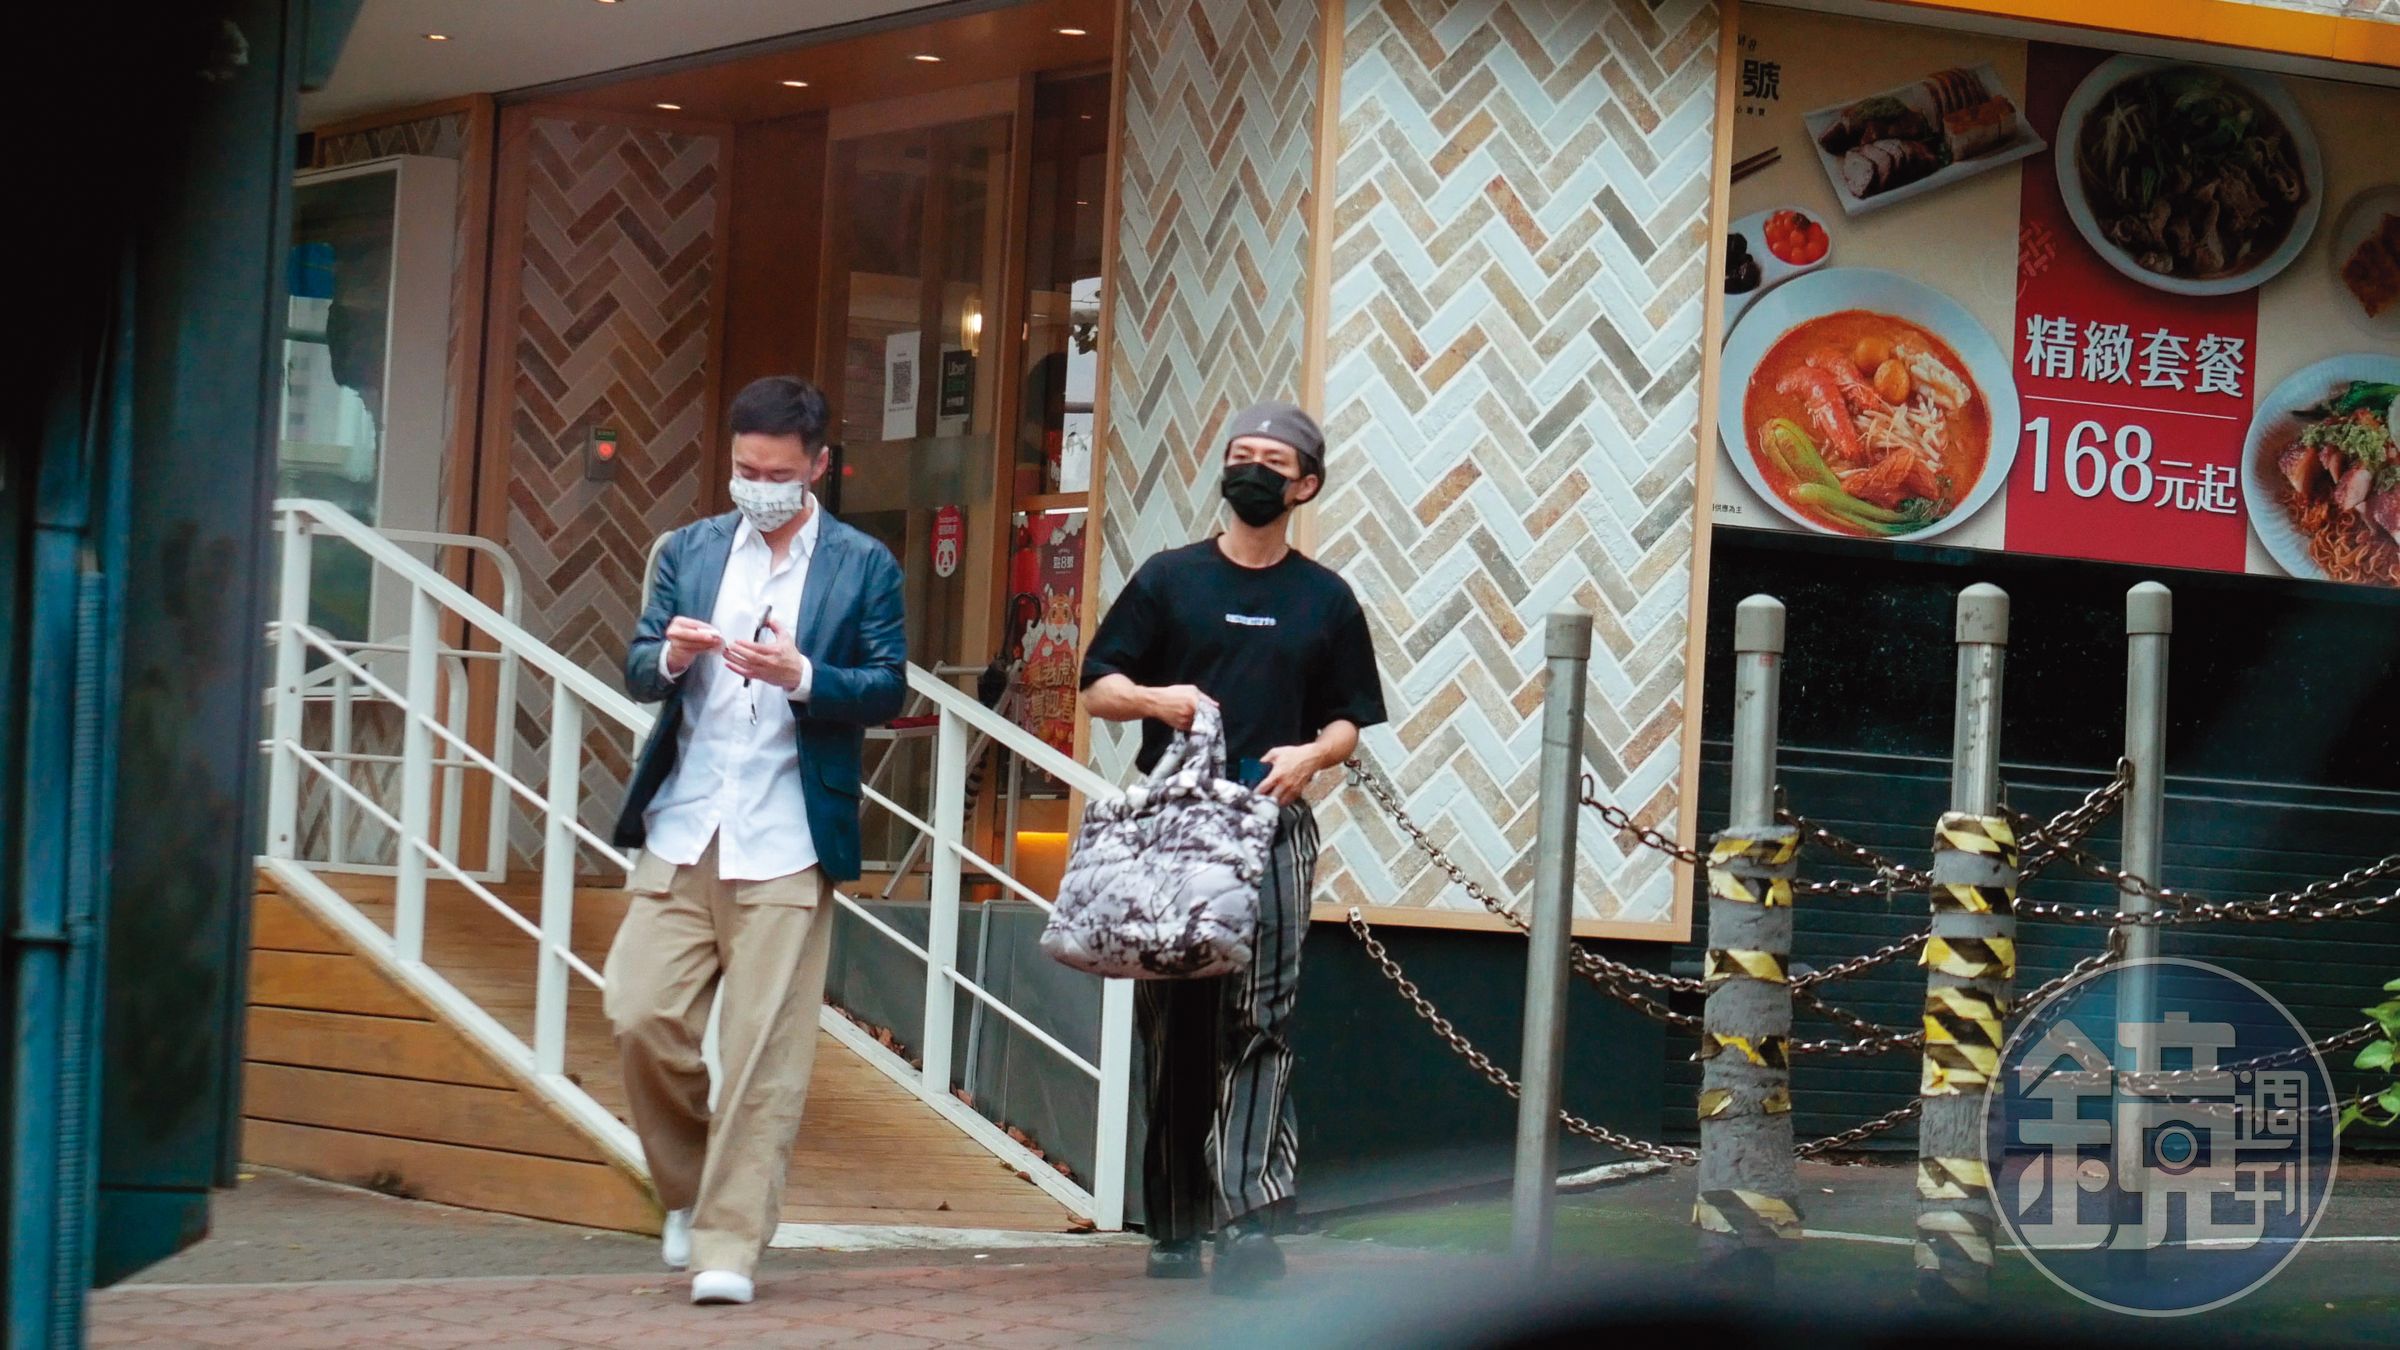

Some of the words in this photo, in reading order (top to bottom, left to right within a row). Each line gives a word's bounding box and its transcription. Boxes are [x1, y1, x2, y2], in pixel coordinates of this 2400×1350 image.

[1743, 59, 1781, 101] 號
[2024, 313, 2245, 398] 精緻套餐
[2025, 416, 2237, 514] 168元起
